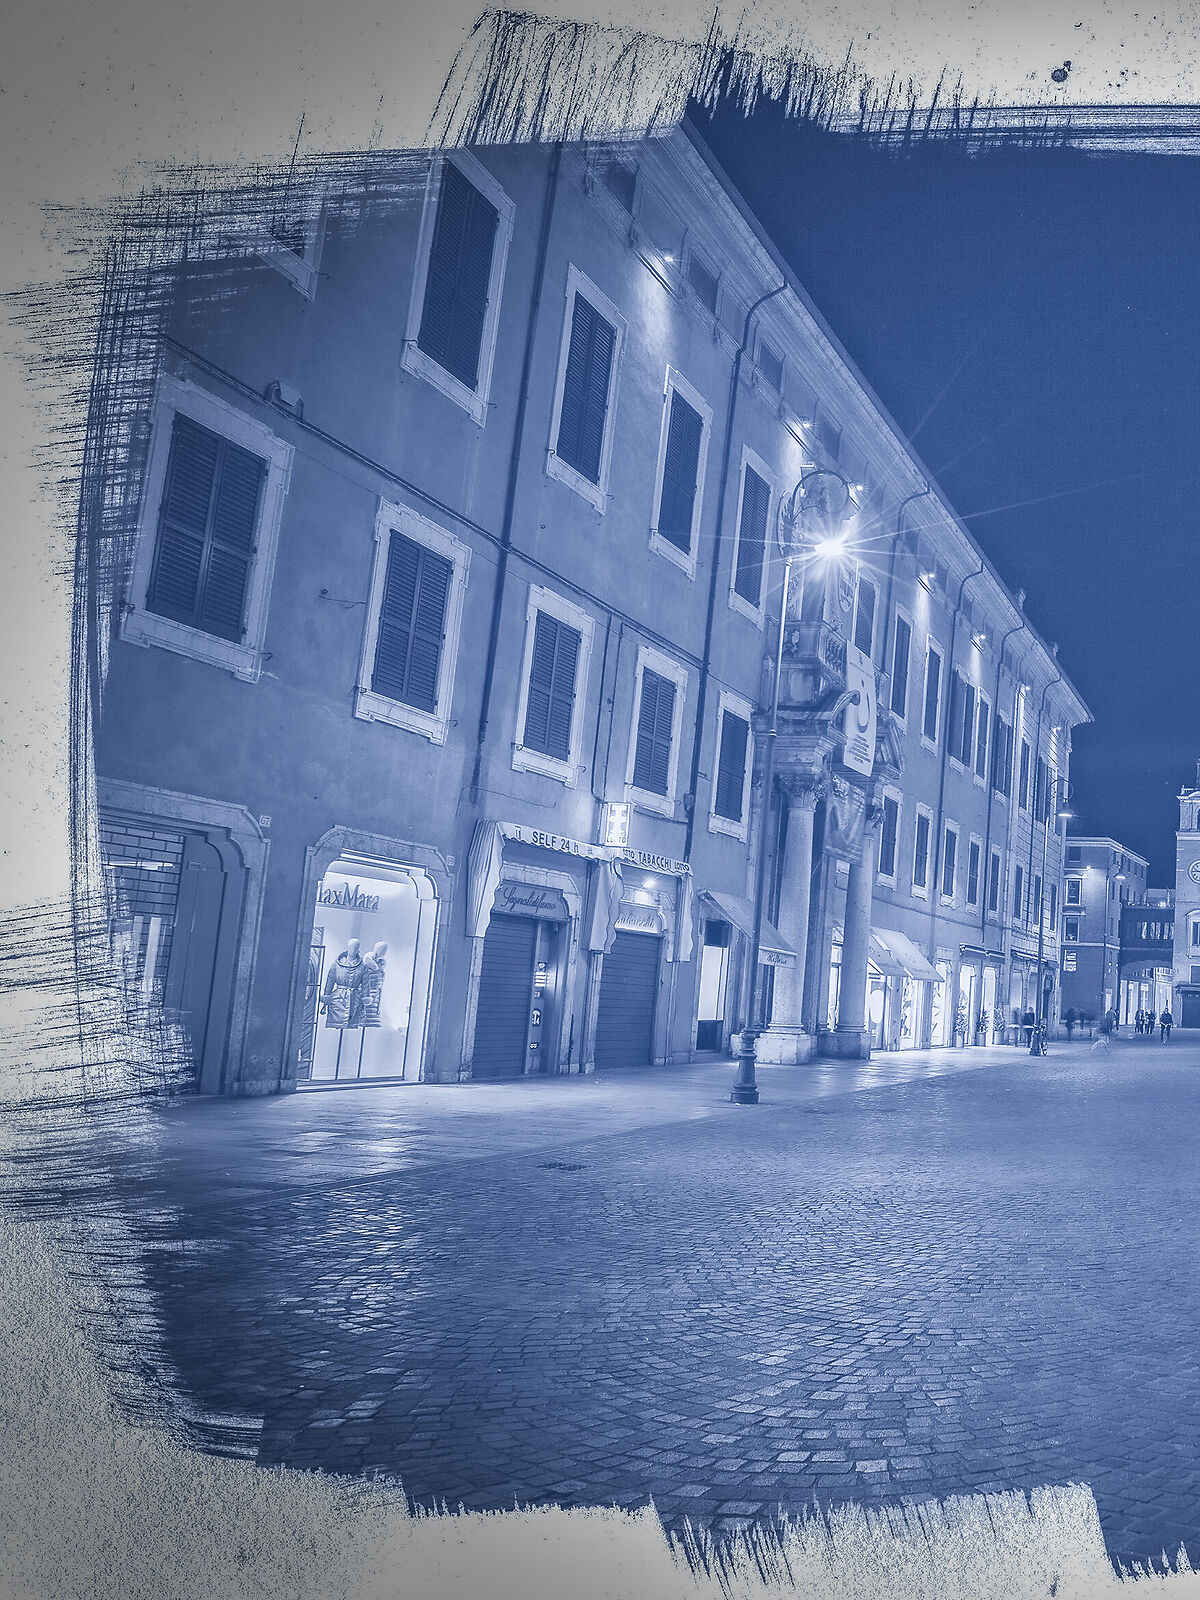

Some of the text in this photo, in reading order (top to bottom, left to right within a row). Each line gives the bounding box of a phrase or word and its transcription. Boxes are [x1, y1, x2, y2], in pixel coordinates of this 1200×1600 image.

[532, 831, 557, 848] SELF
[560, 838, 570, 851] 24
[638, 851, 672, 869] TABACCHI
